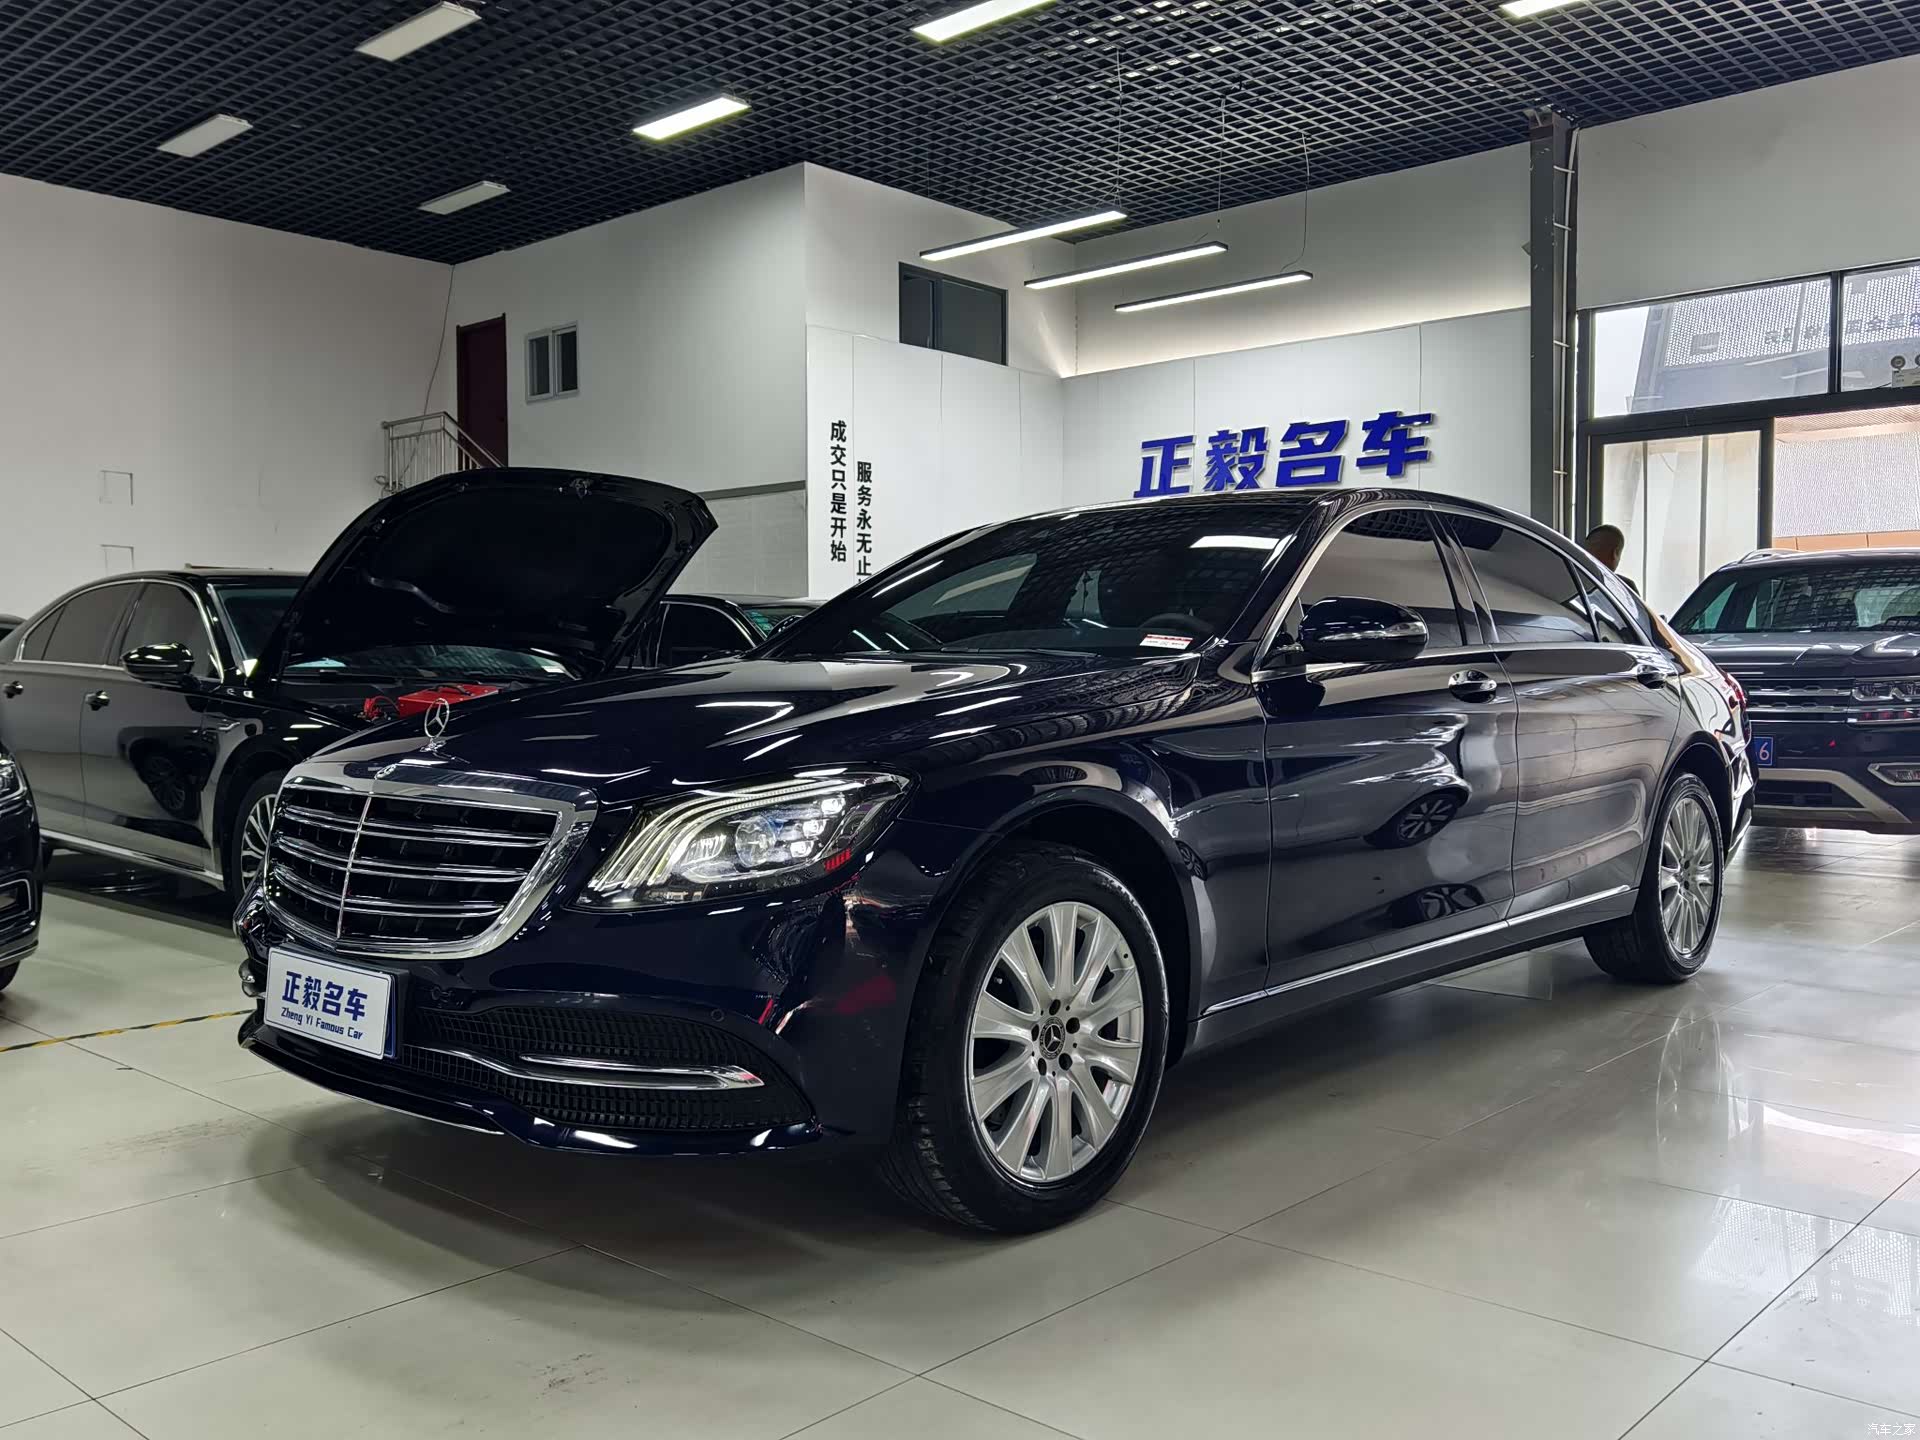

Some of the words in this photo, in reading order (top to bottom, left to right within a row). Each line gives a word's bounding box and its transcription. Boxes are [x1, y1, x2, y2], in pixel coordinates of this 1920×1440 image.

[830, 420, 847, 562] 成交只是开始
[1133, 411, 1435, 498] 正毅名车
[856, 461, 872, 583] 服务永无止
[281, 1006, 303, 1025] Zheng
[316, 1018, 343, 1034] Famous
[347, 1026, 363, 1040] Car
[282, 970, 368, 1022] 正毅名车
